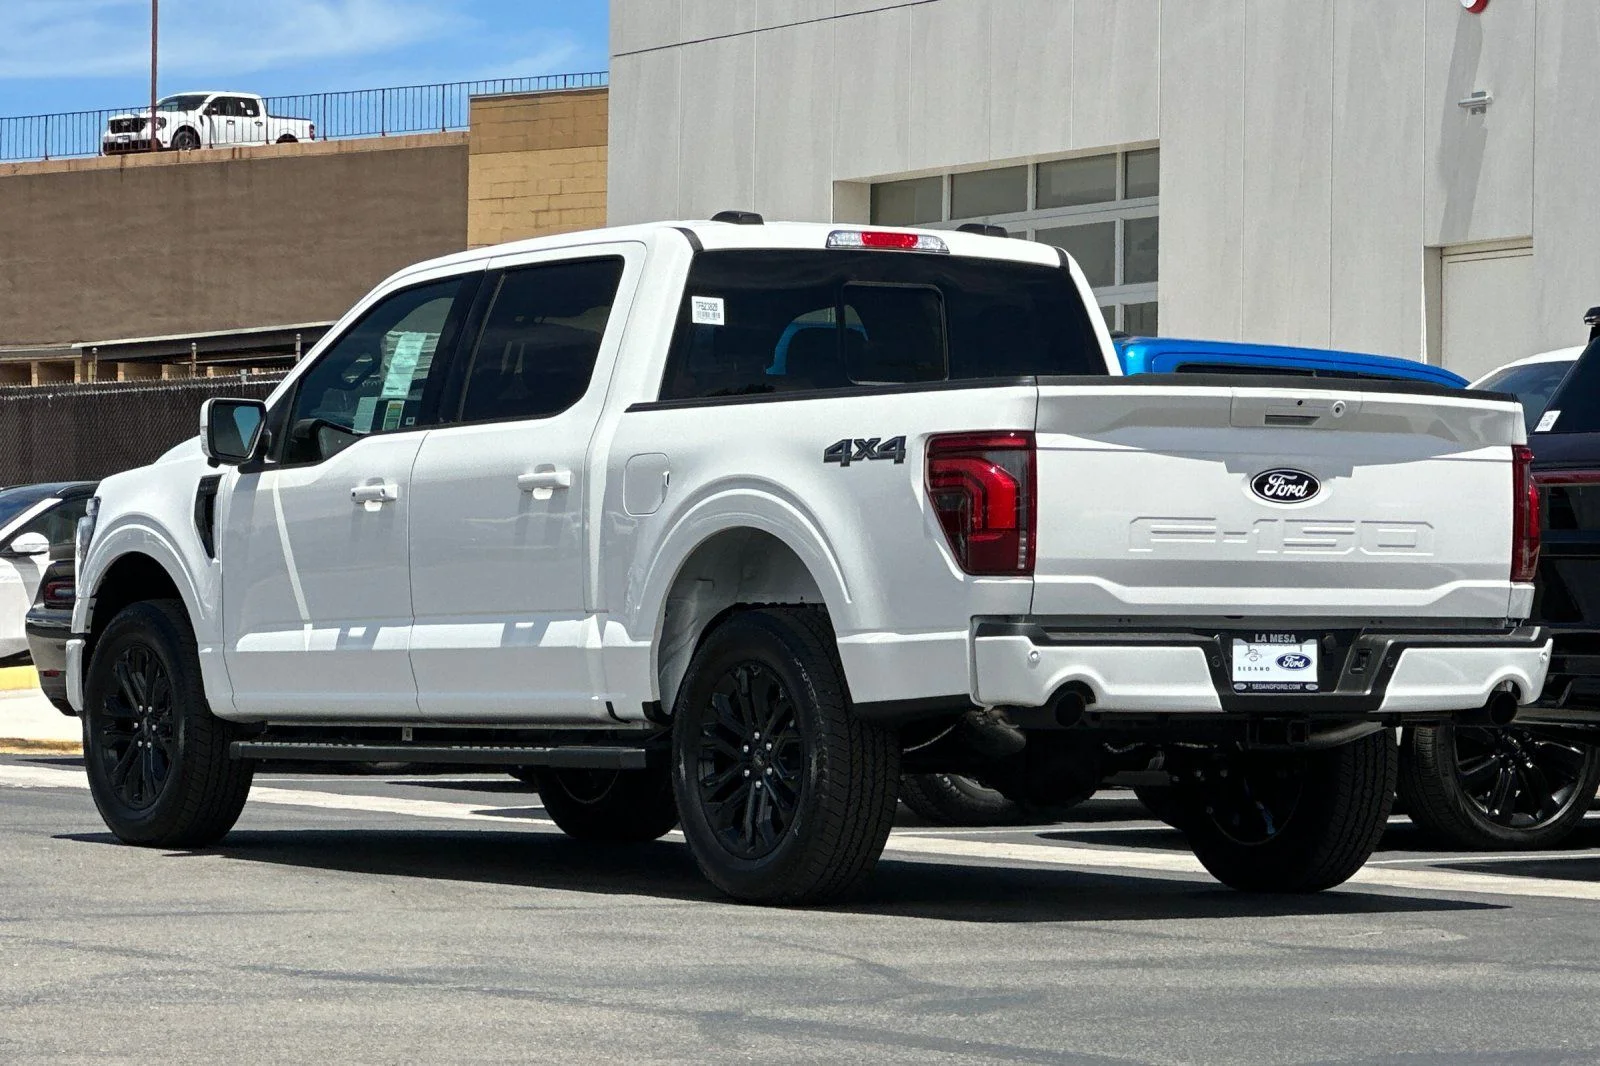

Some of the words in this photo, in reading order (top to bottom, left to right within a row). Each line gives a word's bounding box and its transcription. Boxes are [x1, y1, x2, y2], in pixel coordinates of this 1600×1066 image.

[1263, 473, 1310, 498] Ford
[1128, 516, 1435, 556] F-150
[1254, 633, 1268, 643] LA
[1269, 633, 1297, 643] MESA
[1282, 655, 1306, 668] Ford
